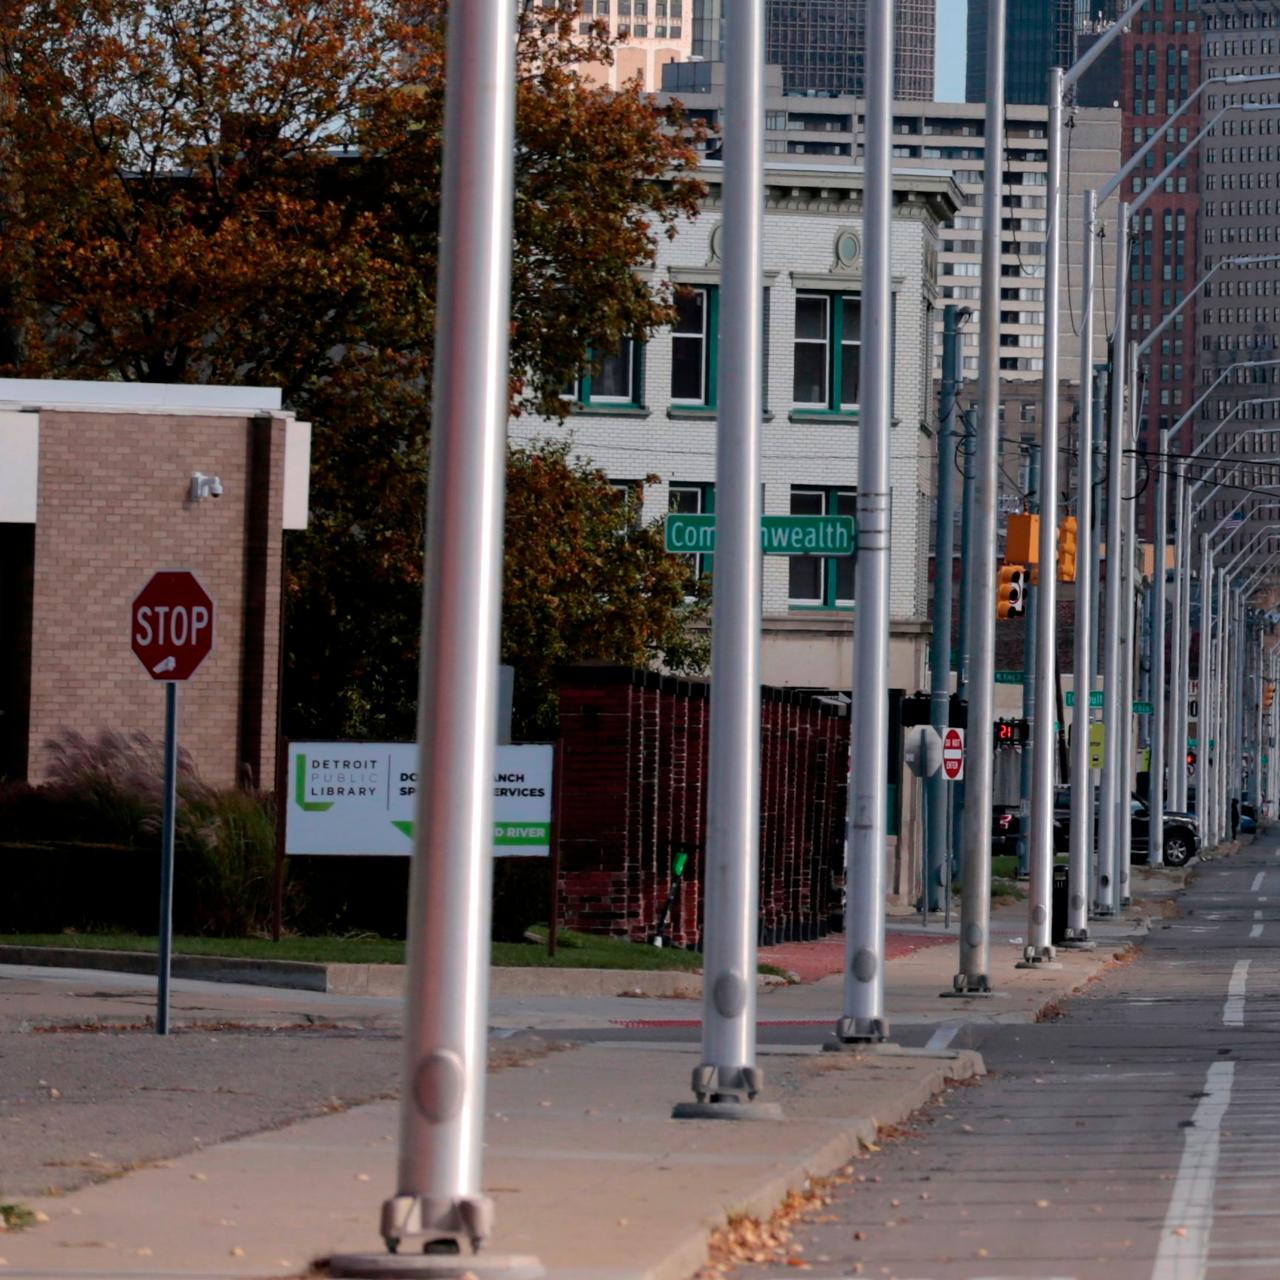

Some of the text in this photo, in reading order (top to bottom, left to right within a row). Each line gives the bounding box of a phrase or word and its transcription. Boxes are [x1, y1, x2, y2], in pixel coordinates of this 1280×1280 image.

[136, 605, 210, 646] STOP
[1000, 725, 1011, 738] 21
[312, 760, 378, 770] DETROIT
[312, 773, 378, 783] PUBLIC
[311, 787, 377, 797] LIBRARY
[494, 788, 546, 798] ERVICES
[506, 827, 546, 838] RIVER
